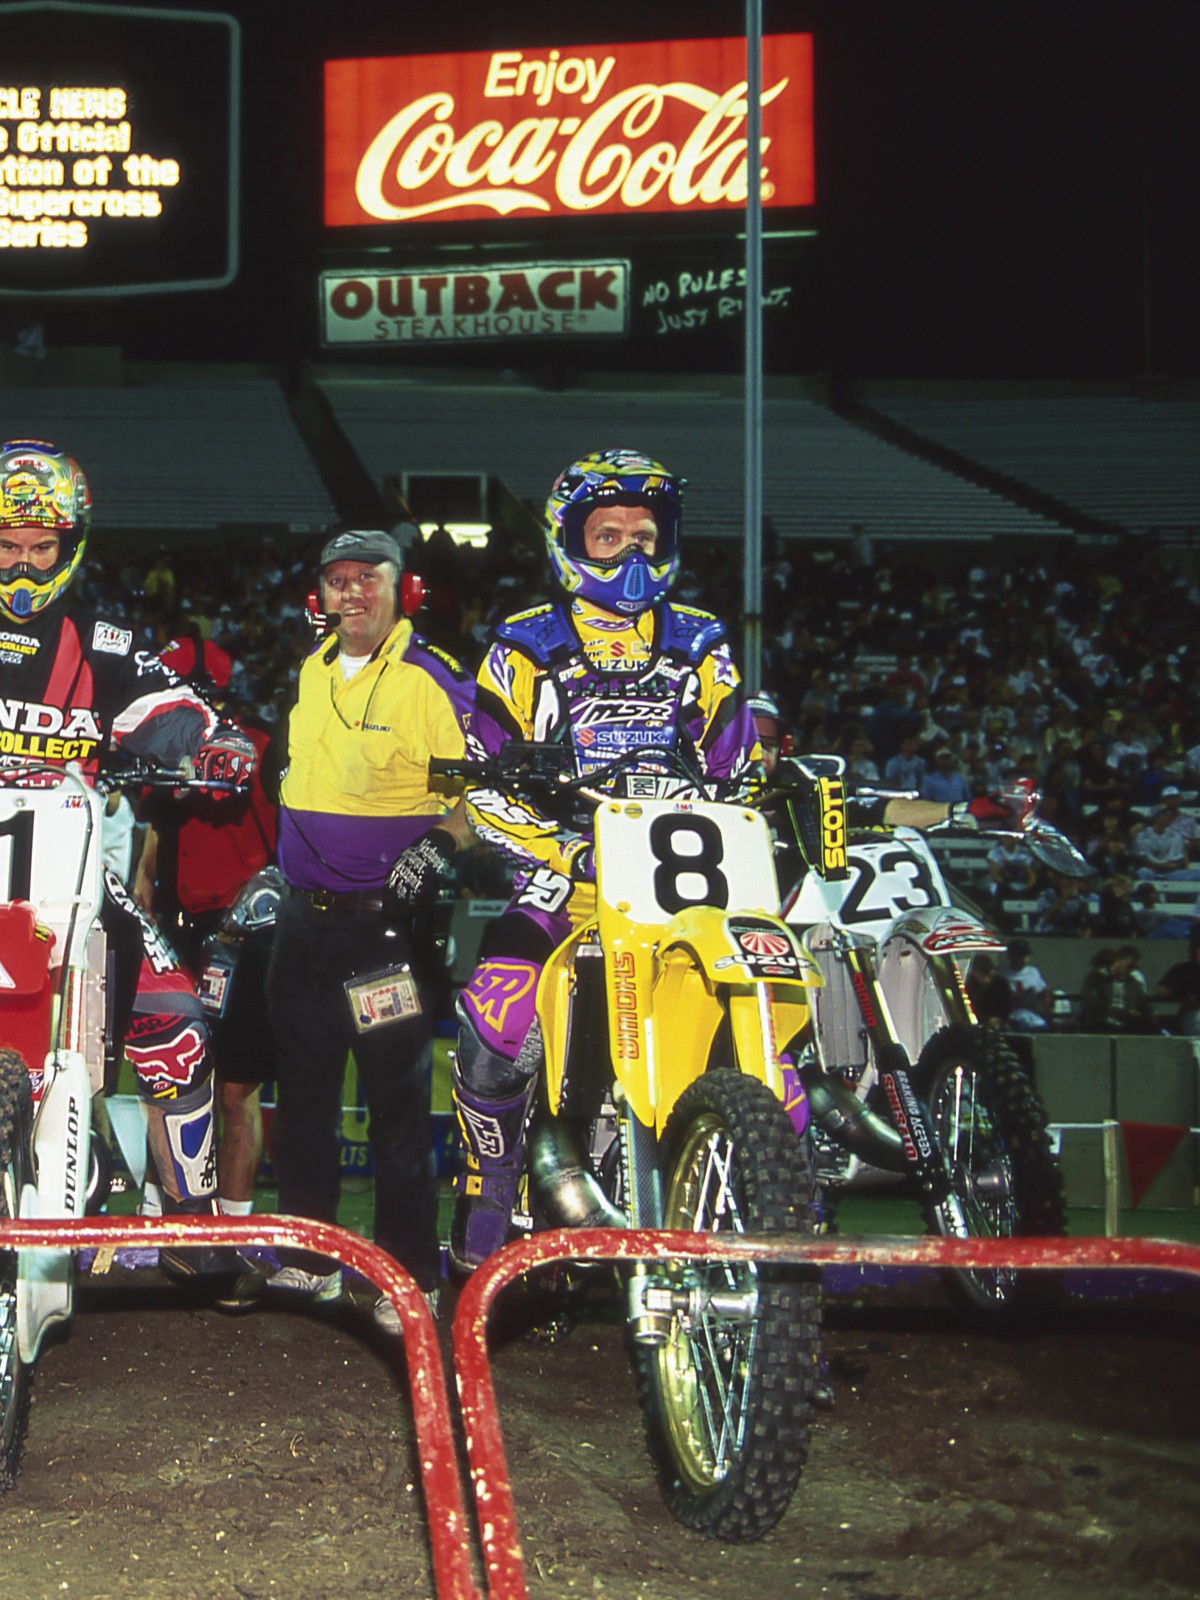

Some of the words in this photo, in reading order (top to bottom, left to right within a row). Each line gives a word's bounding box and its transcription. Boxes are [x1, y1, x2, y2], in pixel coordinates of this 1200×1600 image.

[484, 50, 616, 106] Enjoy
[49, 87, 126, 119] NEWS
[16, 121, 131, 152] Official
[355, 77, 789, 221] Coca-Cola
[72, 155, 112, 186] of
[122, 154, 180, 186] the
[329, 269, 620, 320] OUTBACK
[643, 281, 670, 306] NO
[678, 268, 748, 298] RULES
[374, 313, 577, 340] STEAKHOUSE
[657, 308, 709, 334] JUST
[591, 658, 650, 671] UZUK
[819, 777, 846, 870] SCOTT
[649, 813, 729, 915] 8
[838, 851, 941, 924] 23
[613, 951, 639, 1060] SHOWA
[896, 1069, 921, 1116] BRAKING
[64, 1096, 82, 1215] DUNLOP
